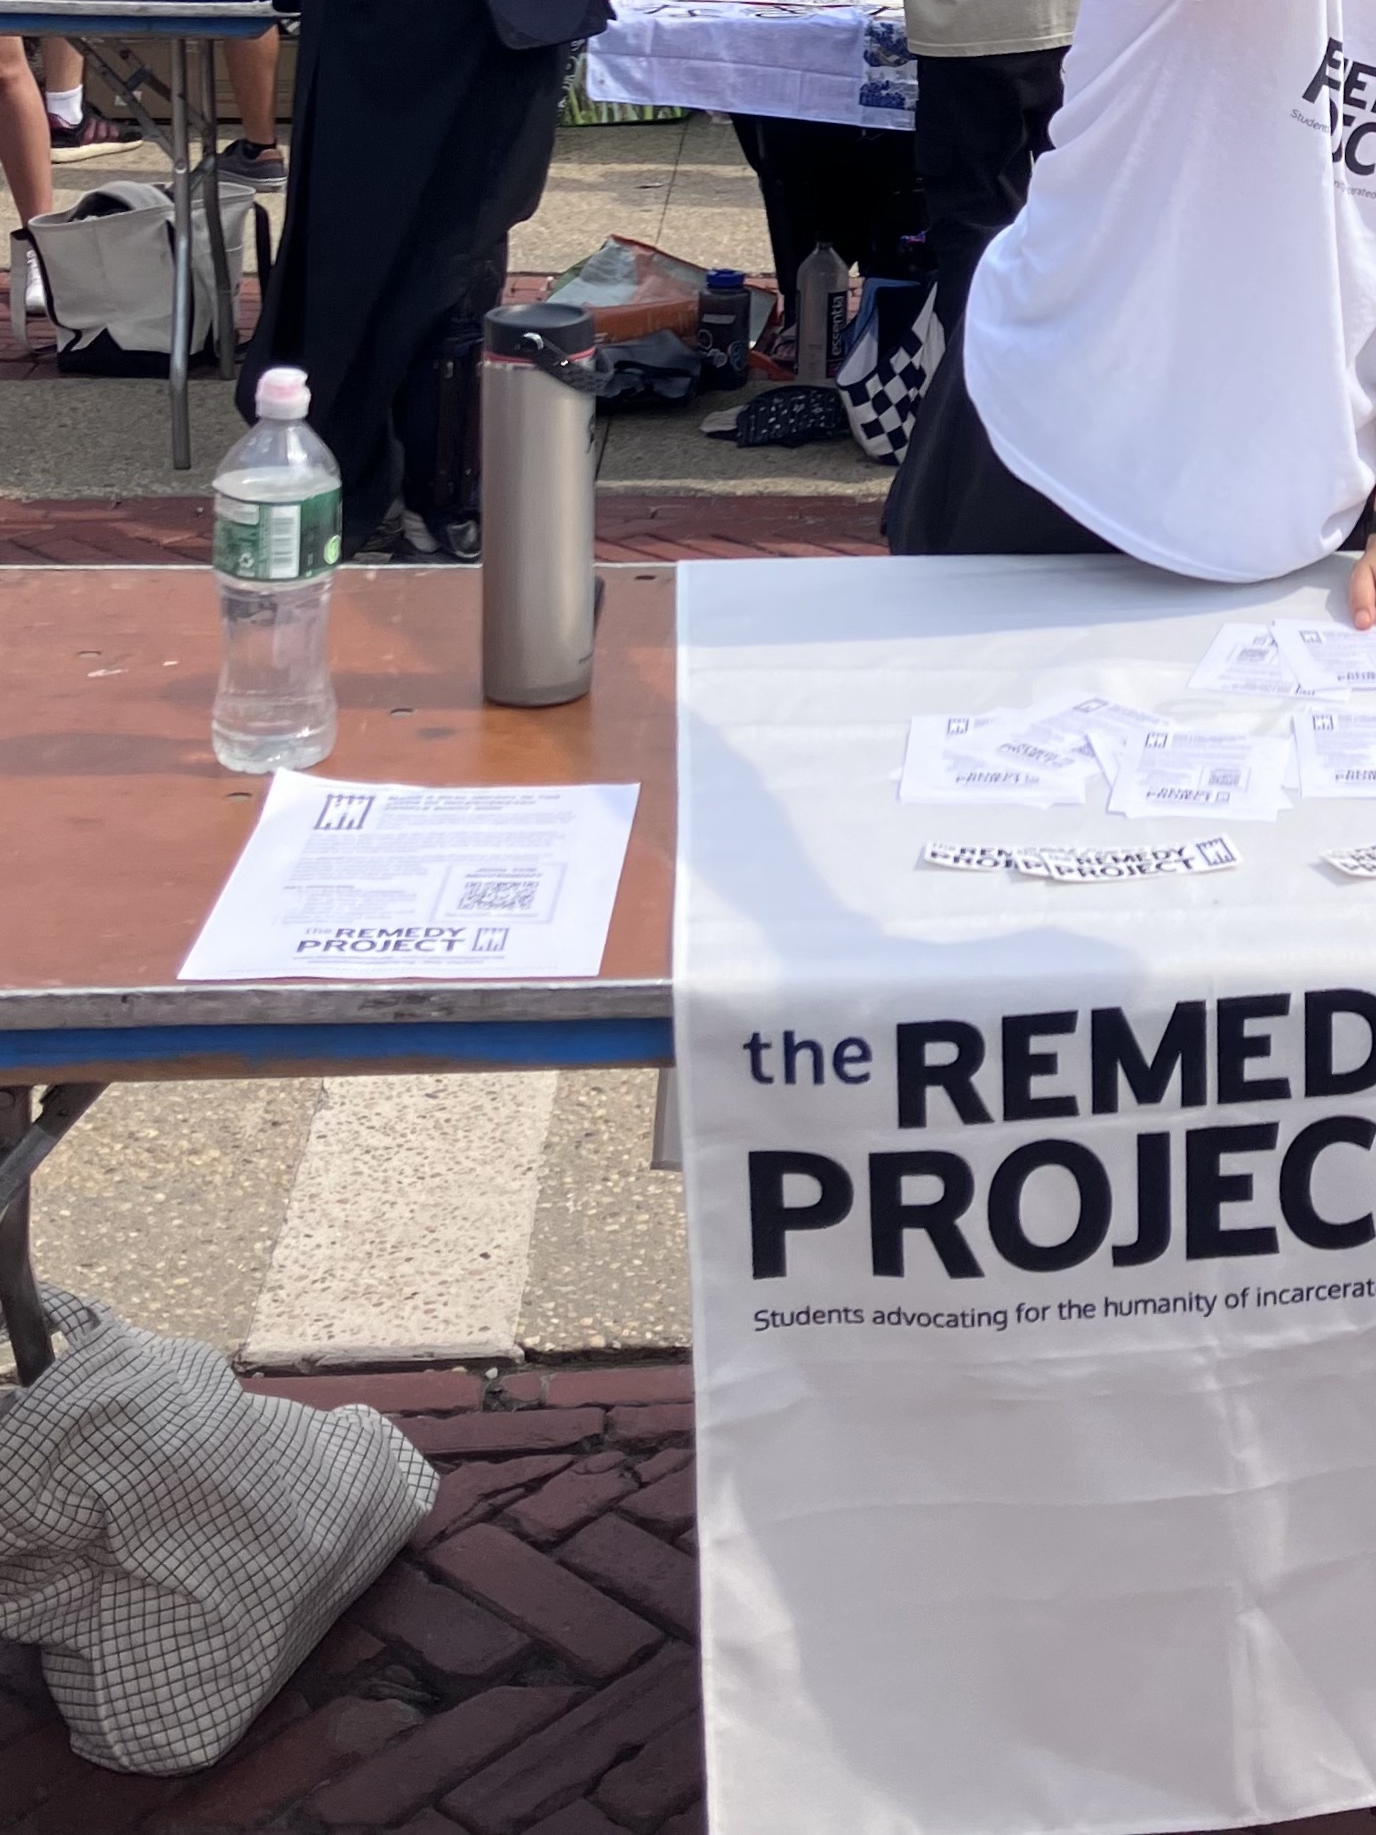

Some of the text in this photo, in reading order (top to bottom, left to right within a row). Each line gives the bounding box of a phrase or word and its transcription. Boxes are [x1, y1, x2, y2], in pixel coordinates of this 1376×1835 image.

[831, 296, 844, 356] essentia
[1076, 845, 1187, 865] REMEDY
[1054, 857, 1194, 878] PROJECT
[335, 926, 468, 939] REMEDY
[296, 938, 466, 953] PROJECT
[742, 1029, 873, 1087] the
[754, 1305, 865, 1331] Students
[872, 1307, 1009, 1331] advocating
[1016, 1302, 1051, 1324] for
[1057, 1298, 1097, 1321] the
[1103, 1292, 1218, 1318] humanity
[1224, 1287, 1251, 1310] of
